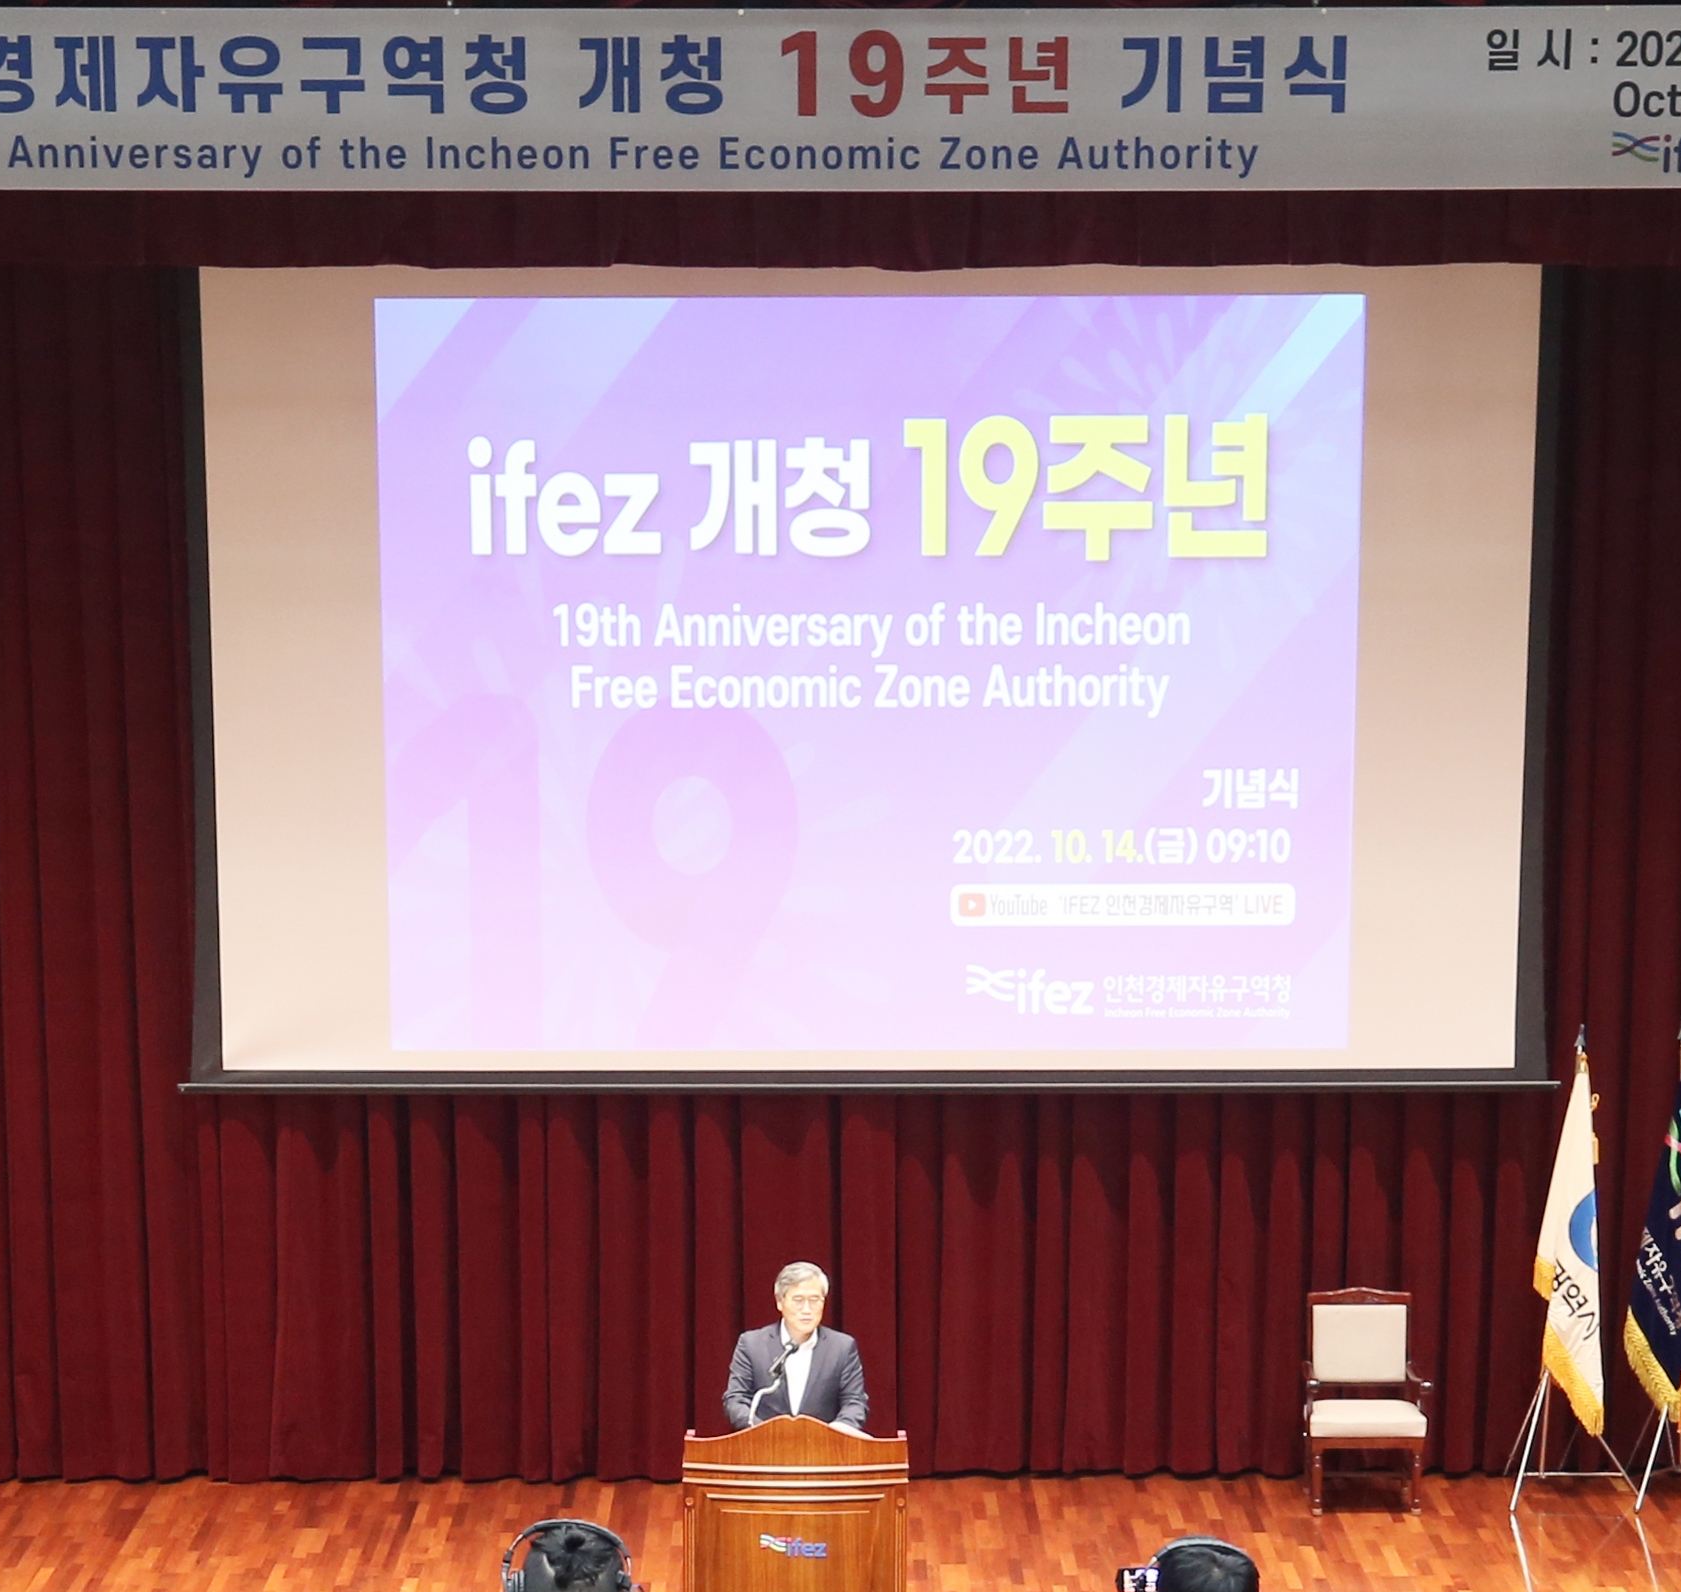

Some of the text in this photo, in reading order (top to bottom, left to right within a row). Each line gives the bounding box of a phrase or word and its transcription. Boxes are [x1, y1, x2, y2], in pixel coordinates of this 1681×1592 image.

[578, 34, 724, 114] 개청
[780, 29, 1069, 118] 19주년
[1121, 35, 1348, 114] 기념식
[8, 135, 263, 178] Anniversary
[281, 135, 321, 170] of
[340, 136, 407, 170] the
[426, 136, 590, 170] Incheon
[610, 136, 700, 170] Free
[720, 136, 921, 170] Economic
[939, 136, 1039, 170] Zone
[1057, 136, 1259, 179] Authority
[467, 413, 1268, 562] ifez 개청 19주년
[552, 602, 1191, 658] 19th Anniversary of the Incheon
[570, 663, 1169, 717] Free Economic Zone Authority
[1202, 767, 1300, 810] 기념식
[952, 828, 1042, 865] 2022.
[1051, 829, 1093, 864] 10.
[1206, 827, 1292, 865] 09:10
[989, 893, 1048, 916] YouTube
[1244, 893, 1284, 915] LIVE
[1017, 967, 1095, 1015] ifez
[1102, 973, 1292, 1004] 인천경제자유구역청
[1103, 1006, 1292, 1020] Incheon Free Economic Zone Authority
[787, 1536, 828, 1558] ifez
